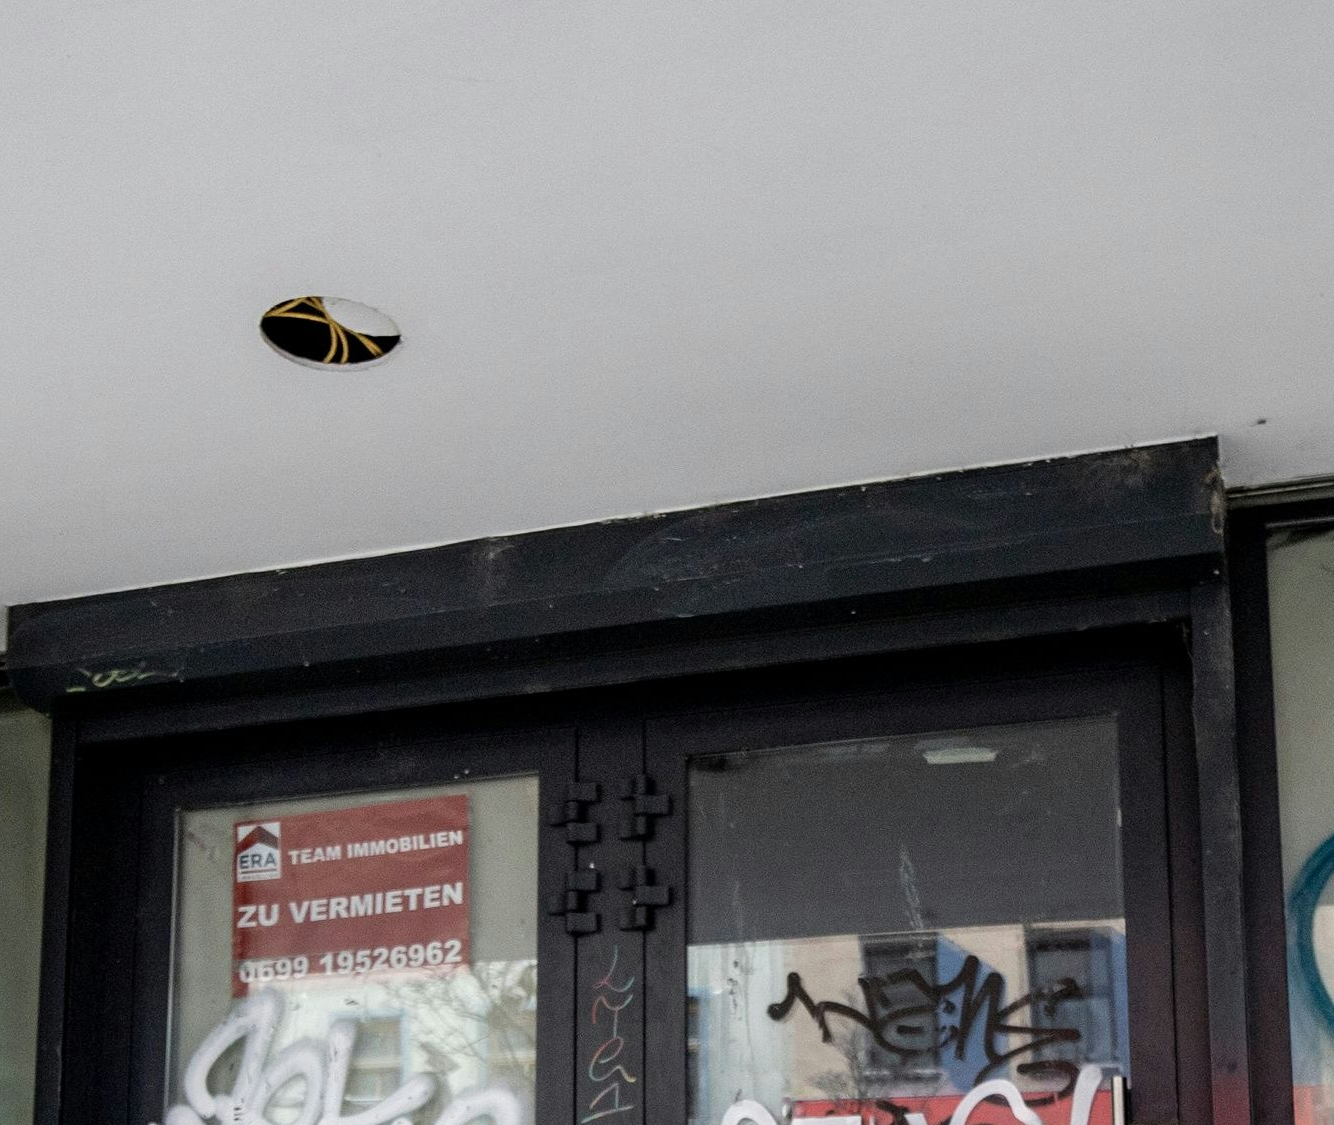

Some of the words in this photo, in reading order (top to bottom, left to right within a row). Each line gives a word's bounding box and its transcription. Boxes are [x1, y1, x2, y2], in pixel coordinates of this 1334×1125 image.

[239, 852, 277, 870] ERA
[289, 845, 342, 866] TEAM
[346, 829, 464, 859] IMMOBILIEN
[237, 905, 279, 928] ZU
[289, 882, 464, 923] VERMIETEN
[238, 955, 309, 985] 0699
[319, 940, 463, 979] 19526962
